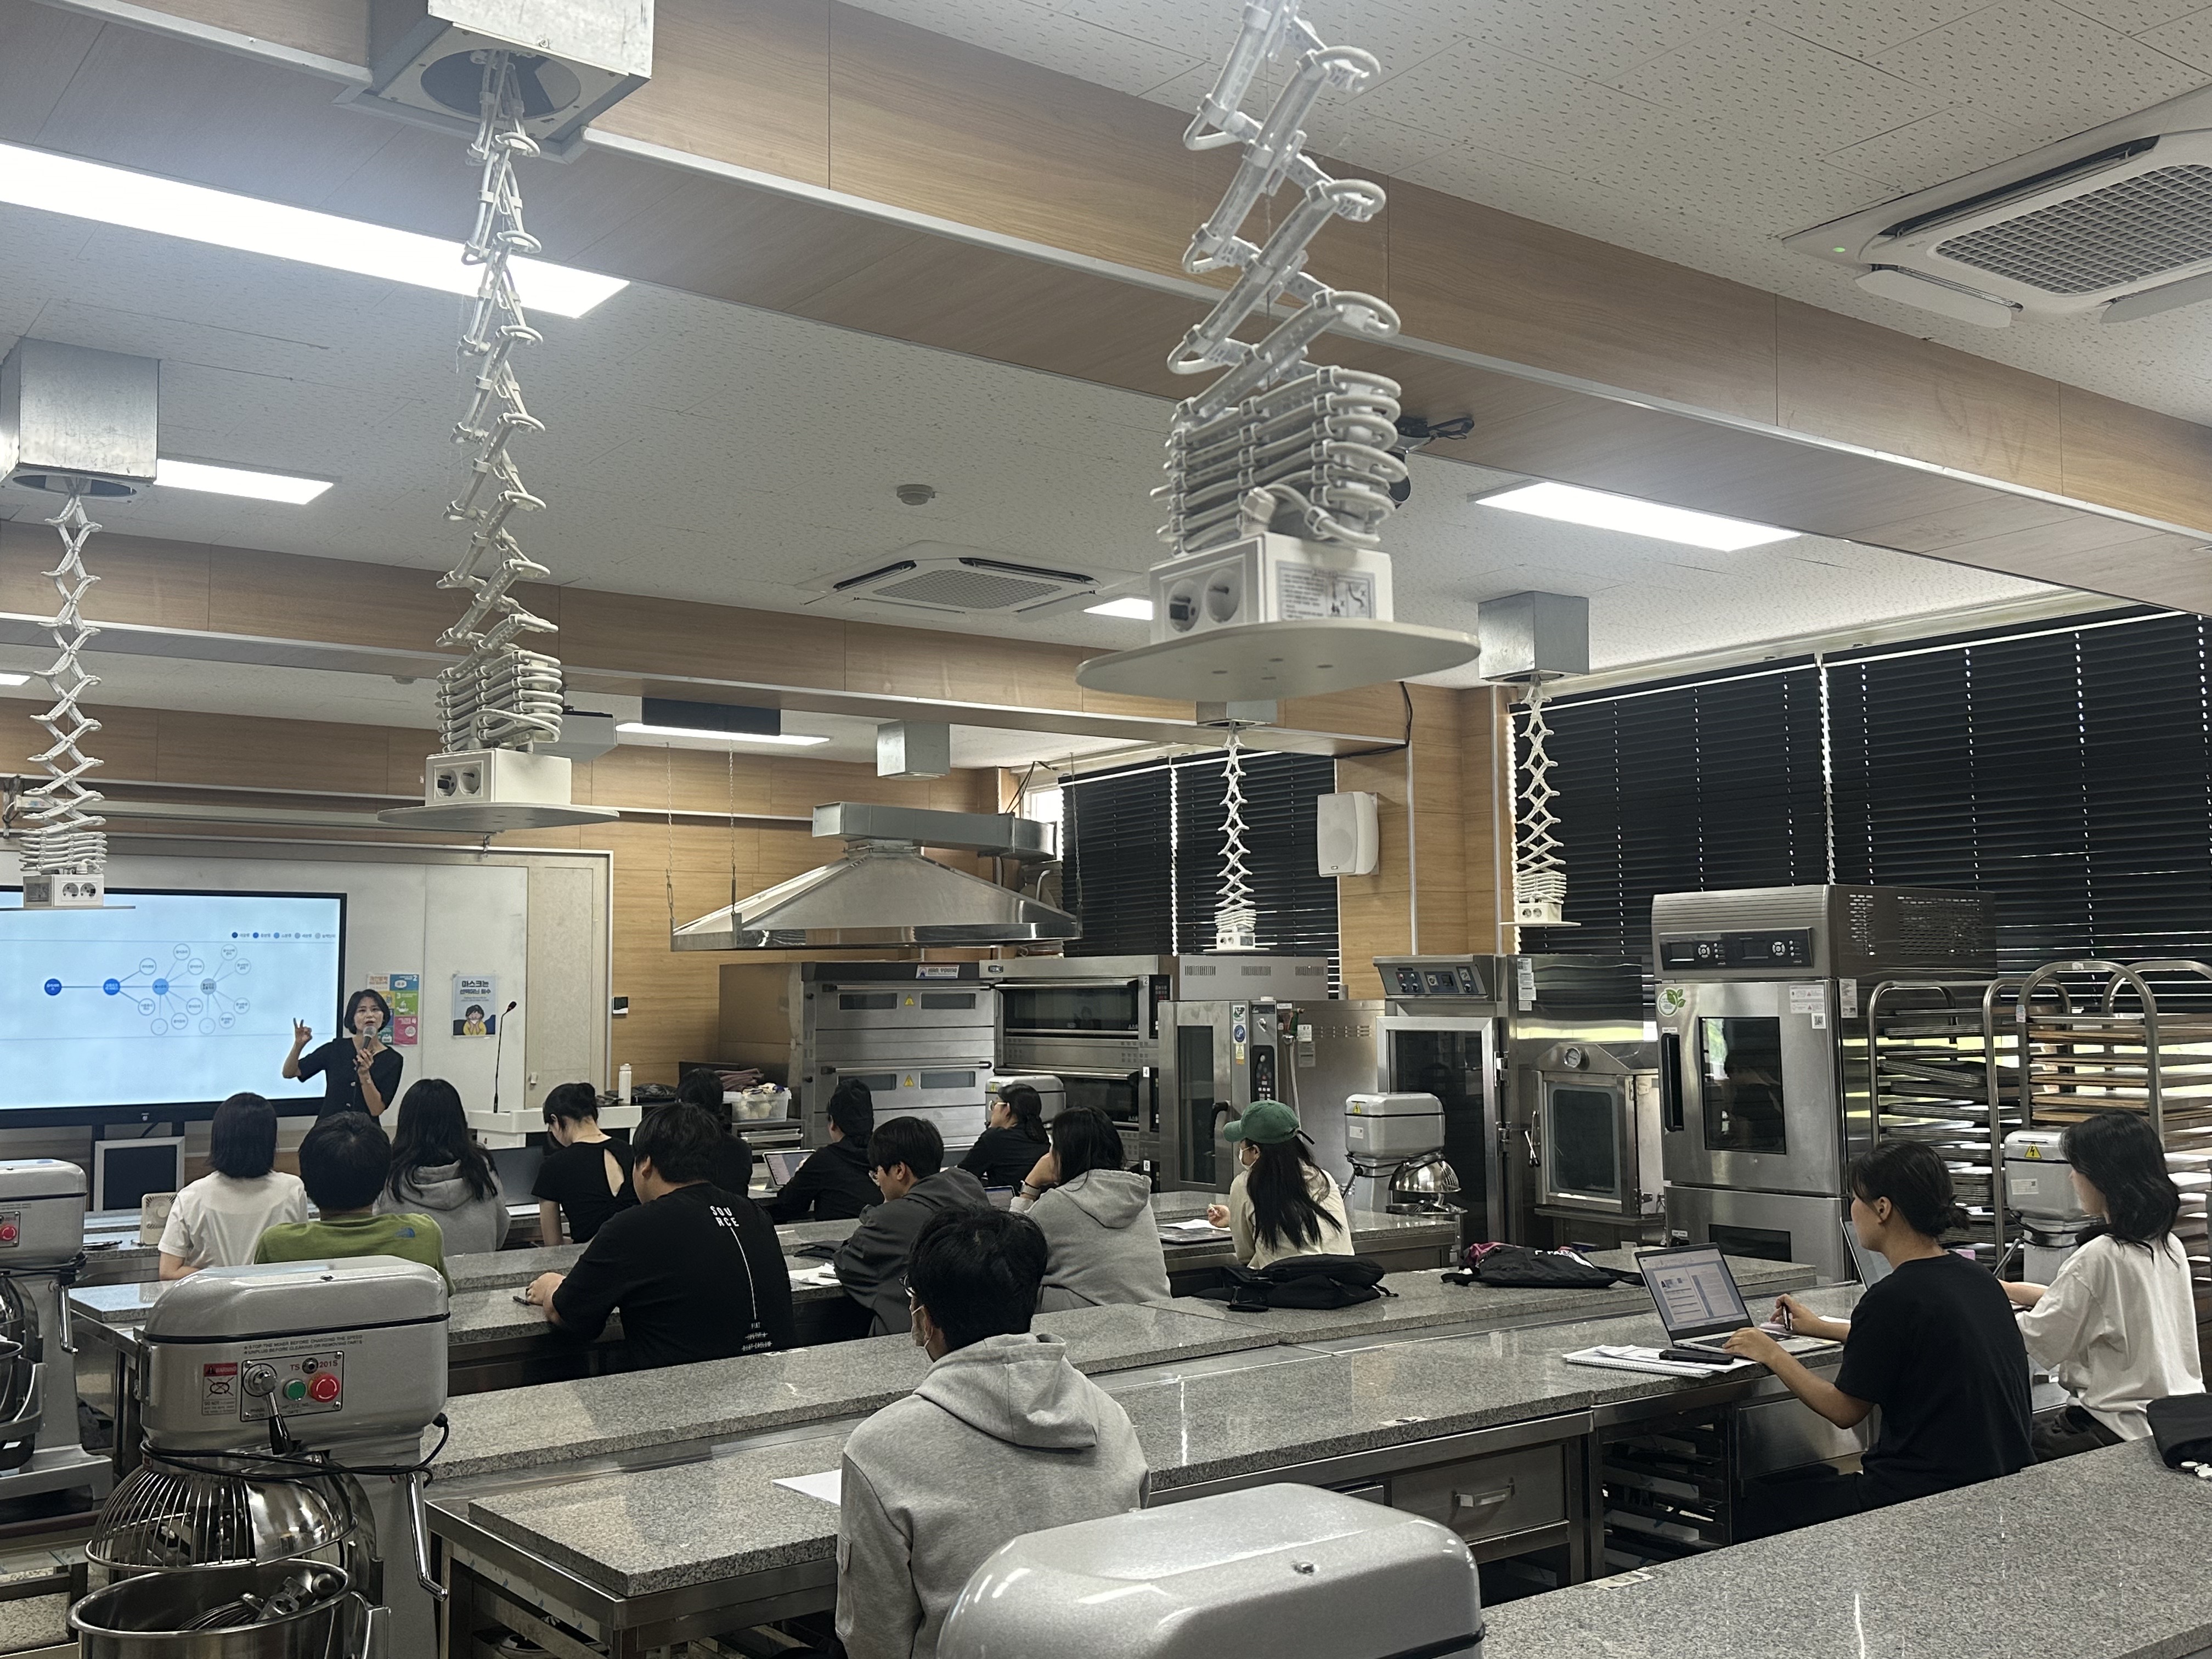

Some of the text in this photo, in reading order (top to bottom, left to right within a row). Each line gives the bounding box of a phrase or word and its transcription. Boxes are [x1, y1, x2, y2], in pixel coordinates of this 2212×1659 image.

[709, 1205, 732, 1216] SOU
[715, 1217, 740, 1227] RCE
[319, 1360, 338, 1368] 201S
